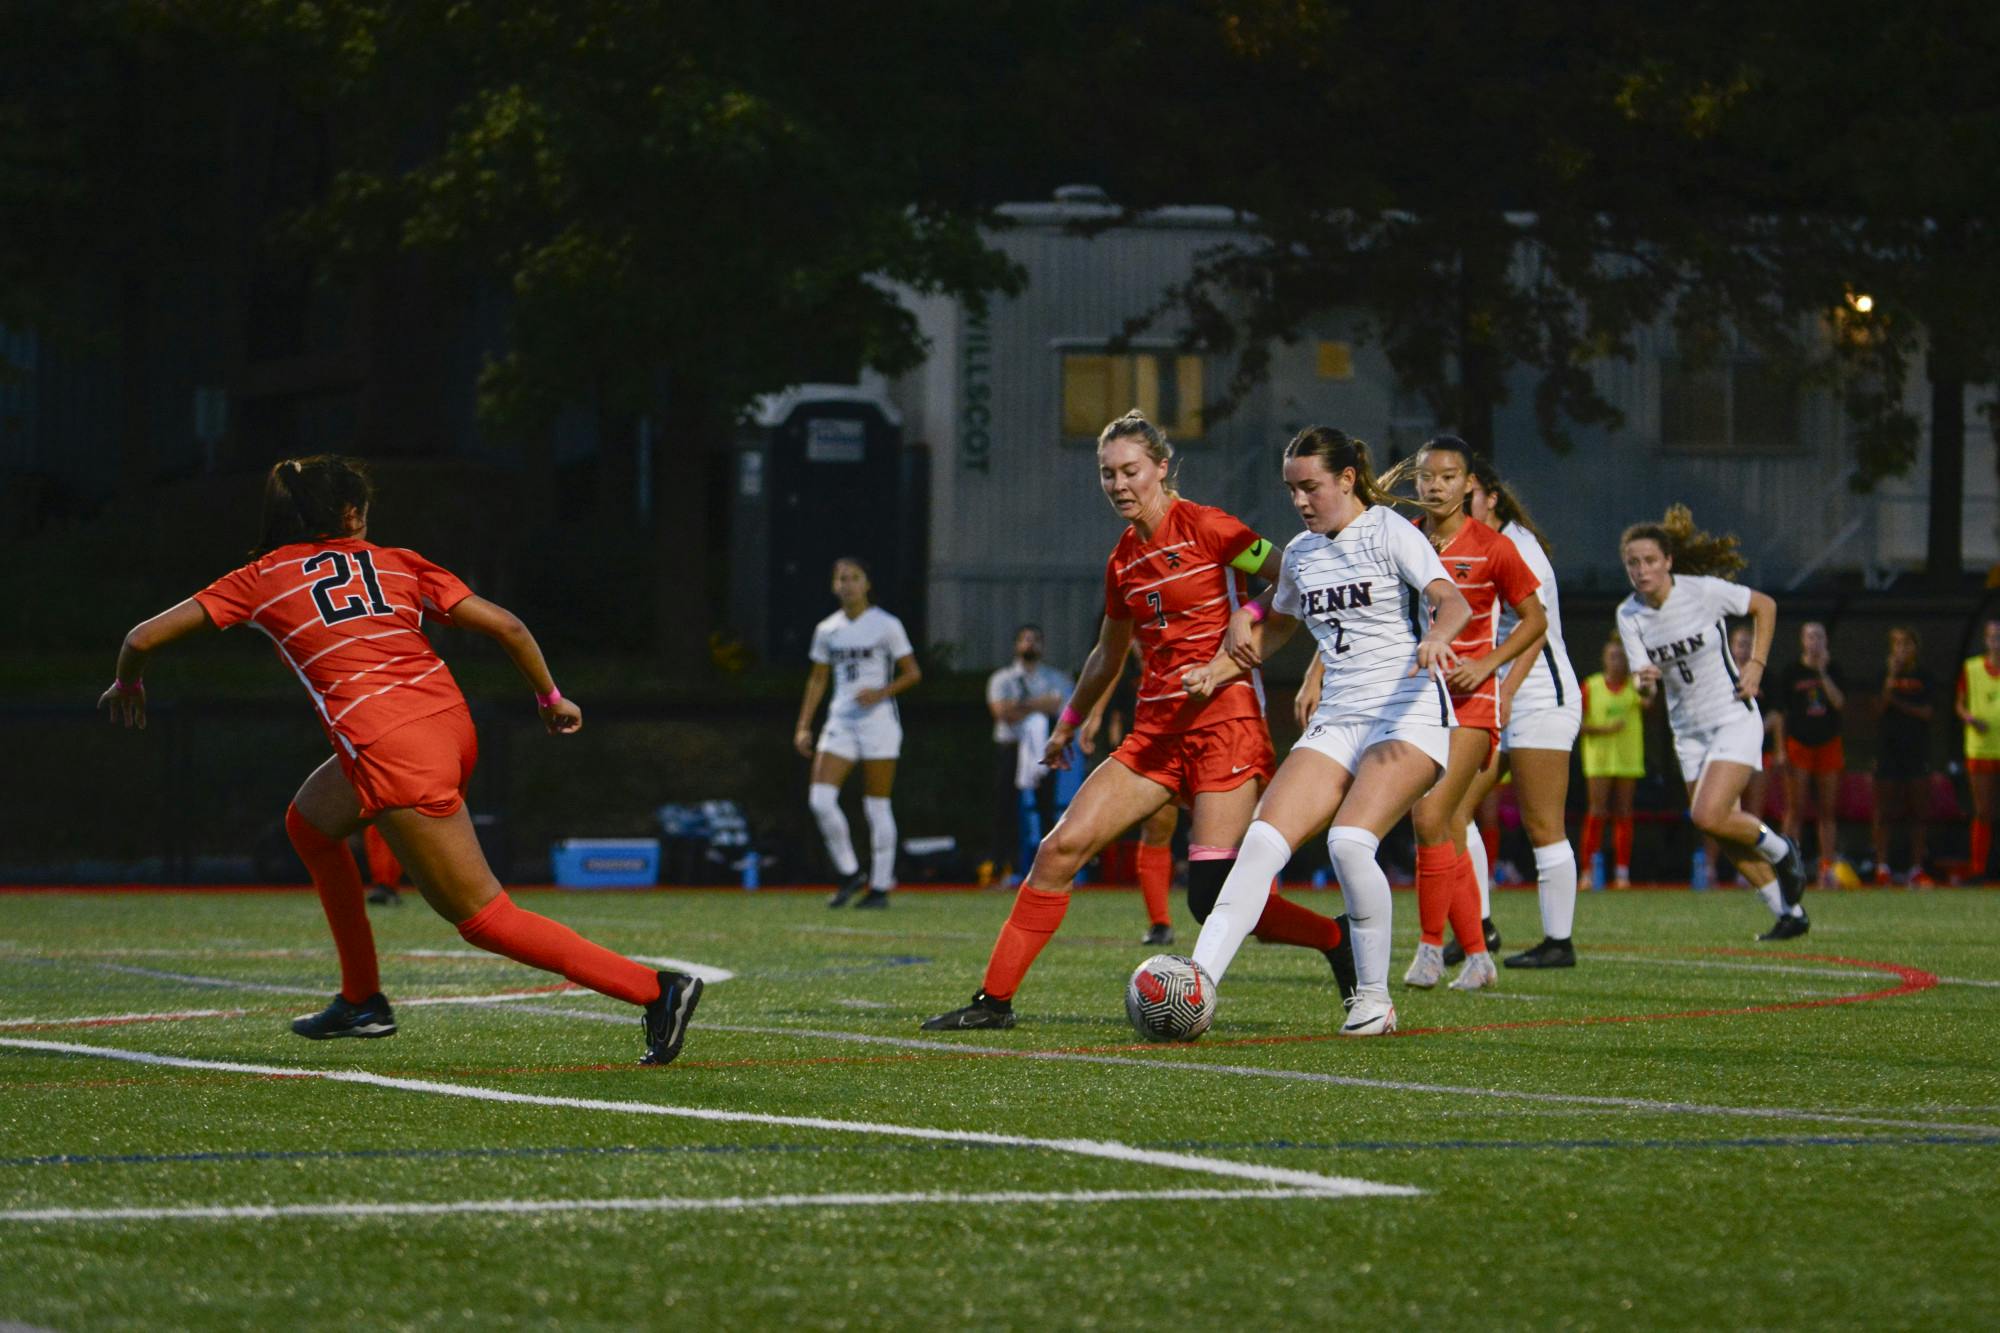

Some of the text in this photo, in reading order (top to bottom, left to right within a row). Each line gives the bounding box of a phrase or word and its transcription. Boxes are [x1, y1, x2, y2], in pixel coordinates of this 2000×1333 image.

[302, 550, 395, 627] 21
[1145, 591, 1168, 628] 7
[1325, 617, 1350, 654] 2
[1678, 660, 1693, 685] 6
